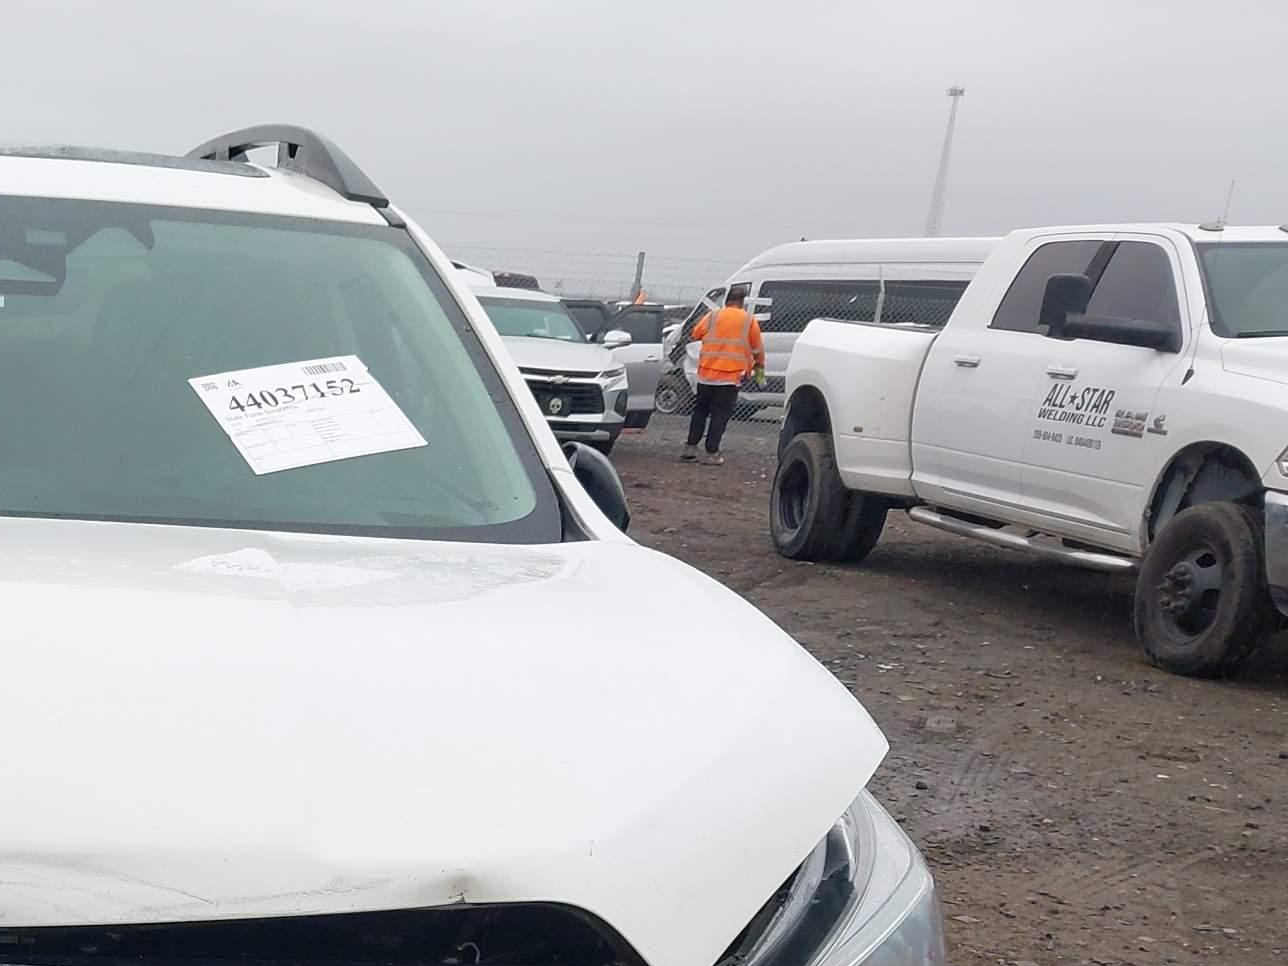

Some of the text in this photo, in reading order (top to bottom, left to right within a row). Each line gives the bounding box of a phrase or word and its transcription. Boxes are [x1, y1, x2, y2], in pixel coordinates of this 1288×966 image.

[228, 378, 361, 412] 44037152
[1042, 383, 1115, 415] ALL STAR
[1037, 407, 1085, 425] WELDING
[1085, 415, 1107, 428] LLC
